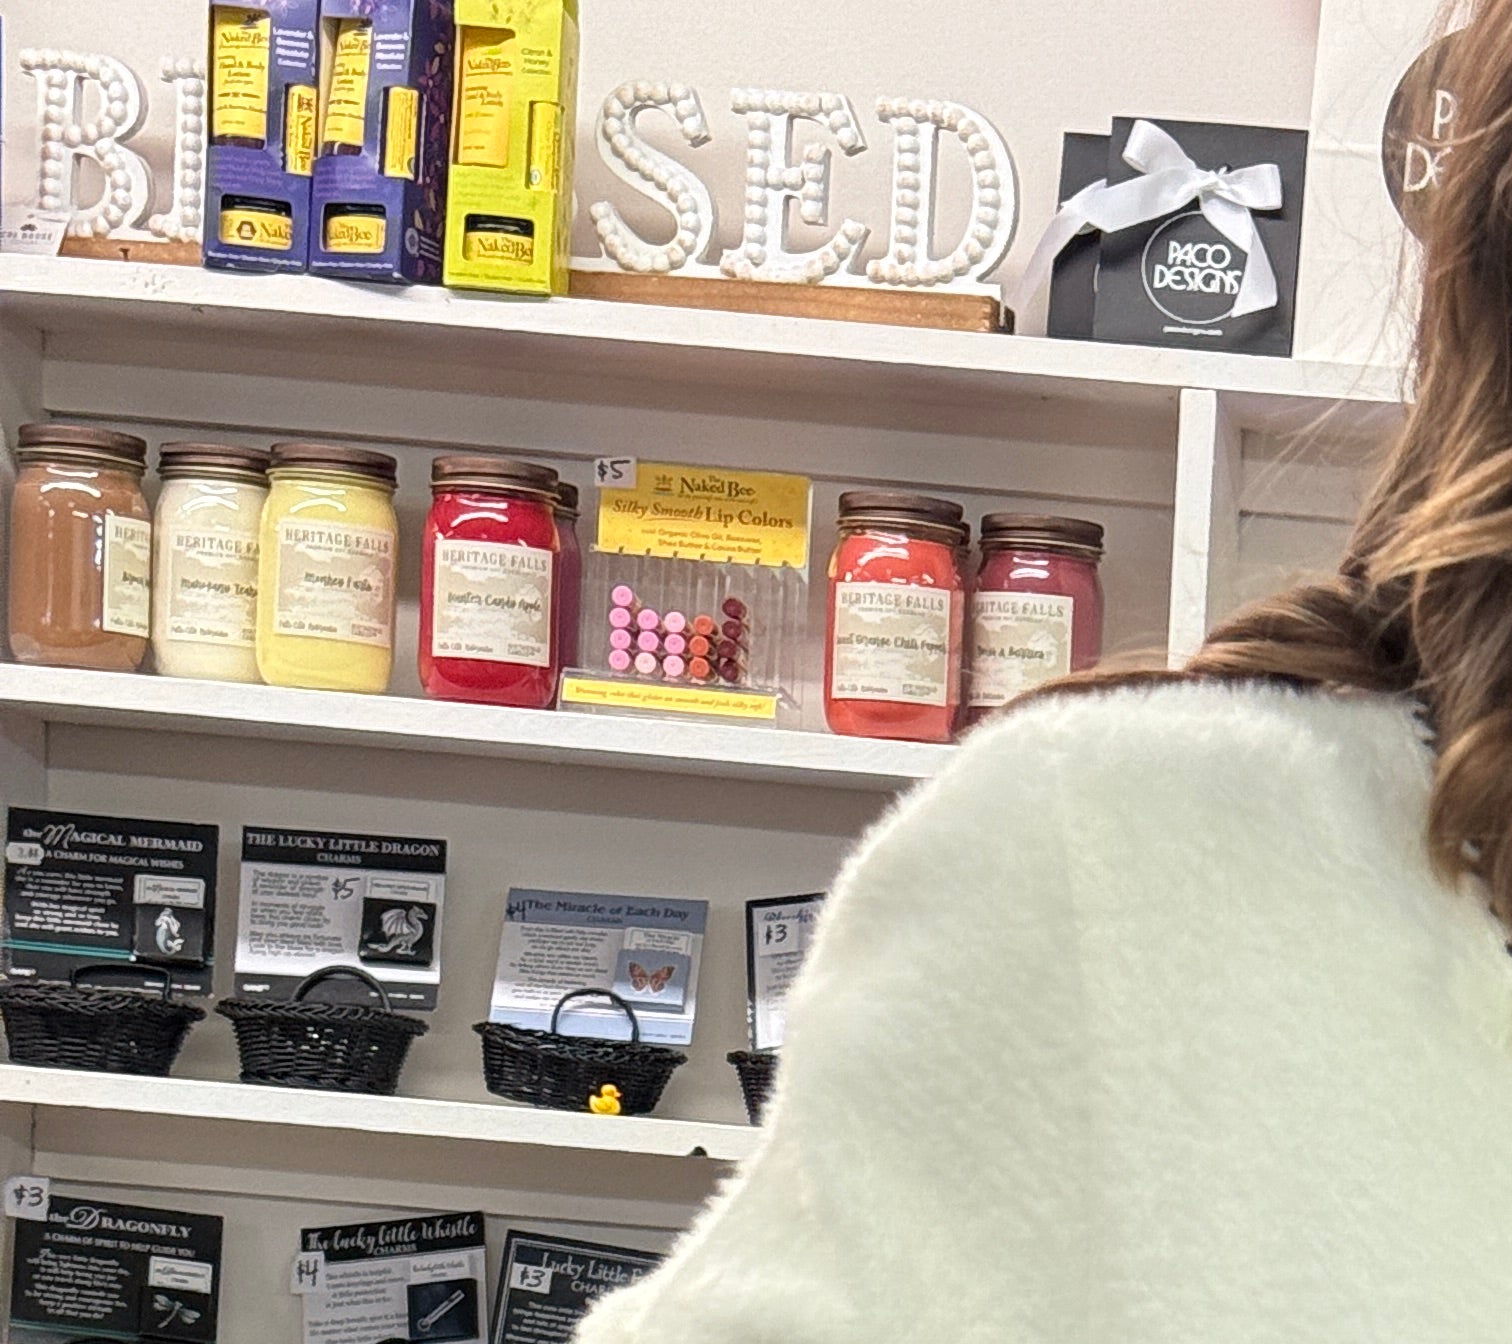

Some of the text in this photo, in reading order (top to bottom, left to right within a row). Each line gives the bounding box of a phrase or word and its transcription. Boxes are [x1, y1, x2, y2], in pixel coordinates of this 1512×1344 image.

[1167, 240, 1232, 269] PACO
[1152, 264, 1242, 295] DESIGNS
[597, 459, 631, 482] $5
[679, 476, 756, 497] Naked Bee
[612, 499, 793, 529] Silky Smooth Lip Colors
[114, 525, 150, 542] HERIT
[176, 535, 243, 552] HERITAGE
[285, 528, 389, 555] HERITAGE FALLS
[442, 549, 547, 572] HERITAGE FALLS
[841, 592, 945, 612] HERITAGE FALLS
[1021, 603, 1065, 618] FALLS
[129, 834, 204, 853] MERMAID
[246, 832, 441, 857] THE LUCKY LITTLE DRAGON
[89, 851, 108, 864] FOR
[110, 855, 149, 867] MAGICAL
[150, 857, 185, 870] WISHES
[316, 852, 363, 864] CHARMS
[331, 877, 361, 901] $5
[527, 898, 690, 922] The Miracle of Each Day
[765, 923, 788, 945] $3
[13, 1184, 44, 1207] $3
[307, 1215, 476, 1250] The Whistle
[297, 1258, 318, 1287] $4
[519, 1266, 546, 1288] $3
[540, 1251, 586, 1279] Lucky
[587, 1259, 629, 1283] Little
